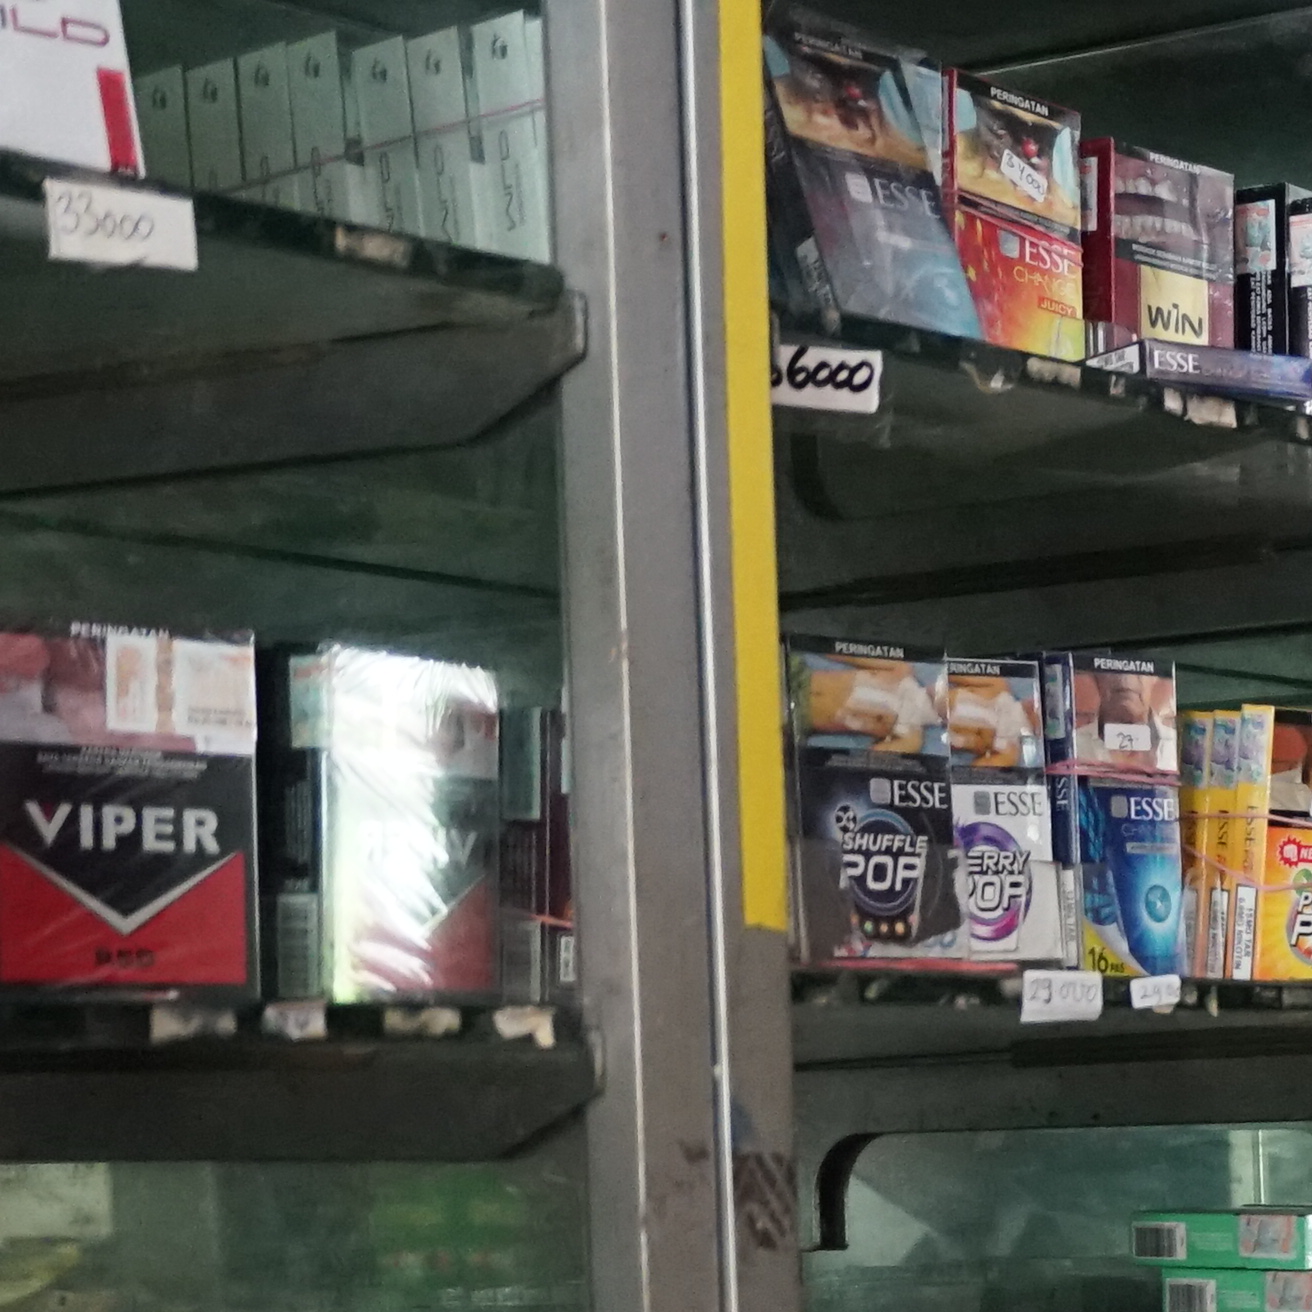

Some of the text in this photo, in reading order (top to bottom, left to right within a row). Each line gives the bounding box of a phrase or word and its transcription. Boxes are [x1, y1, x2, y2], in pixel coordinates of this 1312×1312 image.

[990, 86, 1049, 117] PERINGATAN
[873, 176, 941, 219] ESSE
[1024, 239, 1076, 276] ESSE
[1146, 302, 1204, 339] WIN
[1153, 348, 1201, 375] ESSE
[836, 641, 904, 658] PERINGATAN
[948, 661, 1000, 675] RINGATAN
[1094, 657, 1154, 673] PERINGATAN
[892, 780, 948, 809] ESSE
[993, 791, 1043, 816] ESSE
[1055, 777, 1069, 812] SSE
[1130, 797, 1175, 821] ESSE
[22, 799, 221, 856] VIPER
[842, 834, 929, 854] SHUFFLE
[838, 855, 925, 892] POP
[1088, 945, 1109, 974] 16
